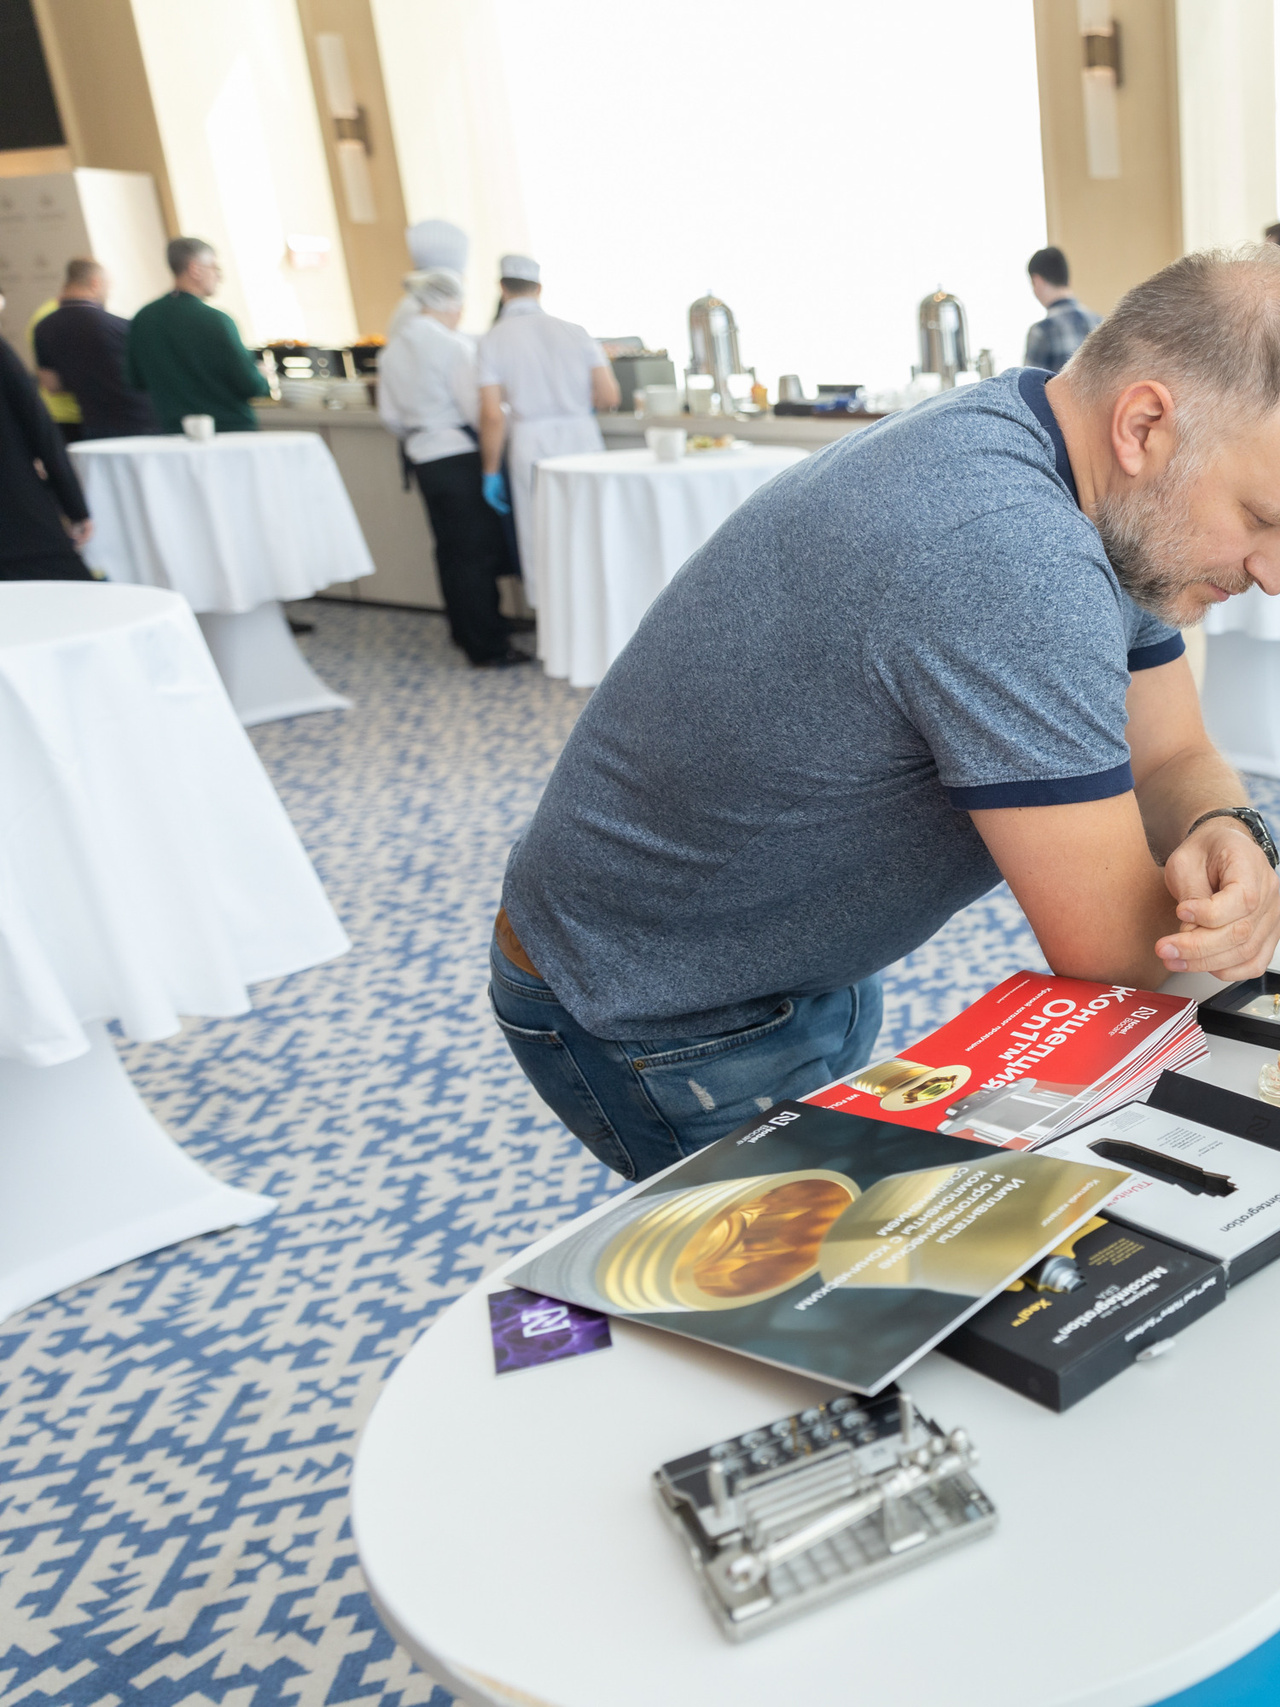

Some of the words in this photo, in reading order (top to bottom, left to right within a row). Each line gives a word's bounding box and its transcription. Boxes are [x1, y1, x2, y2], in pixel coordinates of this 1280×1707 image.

[1023, 987, 1053, 1007] Краткий
[999, 1006, 1025, 1026] каталог
[1107, 1017, 1133, 1037] Biocare
[1118, 1019, 1140, 1034] Nobel
[964, 1027, 1001, 1051] продукции
[980, 985, 1137, 1090] Концепция
[747, 1126, 776, 1143] Nobel
[990, 1173, 1004, 1183] и
[875, 1167, 969, 1238] соединением
[1067, 1179, 1100, 1202] Краткий
[900, 1170, 988, 1236] компоненты
[934, 1177, 1025, 1245] Имплантаты
[1040, 1203, 1069, 1227] каталог
[876, 1182, 993, 1271] ортопедические
[793, 1243, 888, 1311] коническим
[1094, 1283, 1120, 1299] ERA
[1120, 1282, 1160, 1307] Welcome
